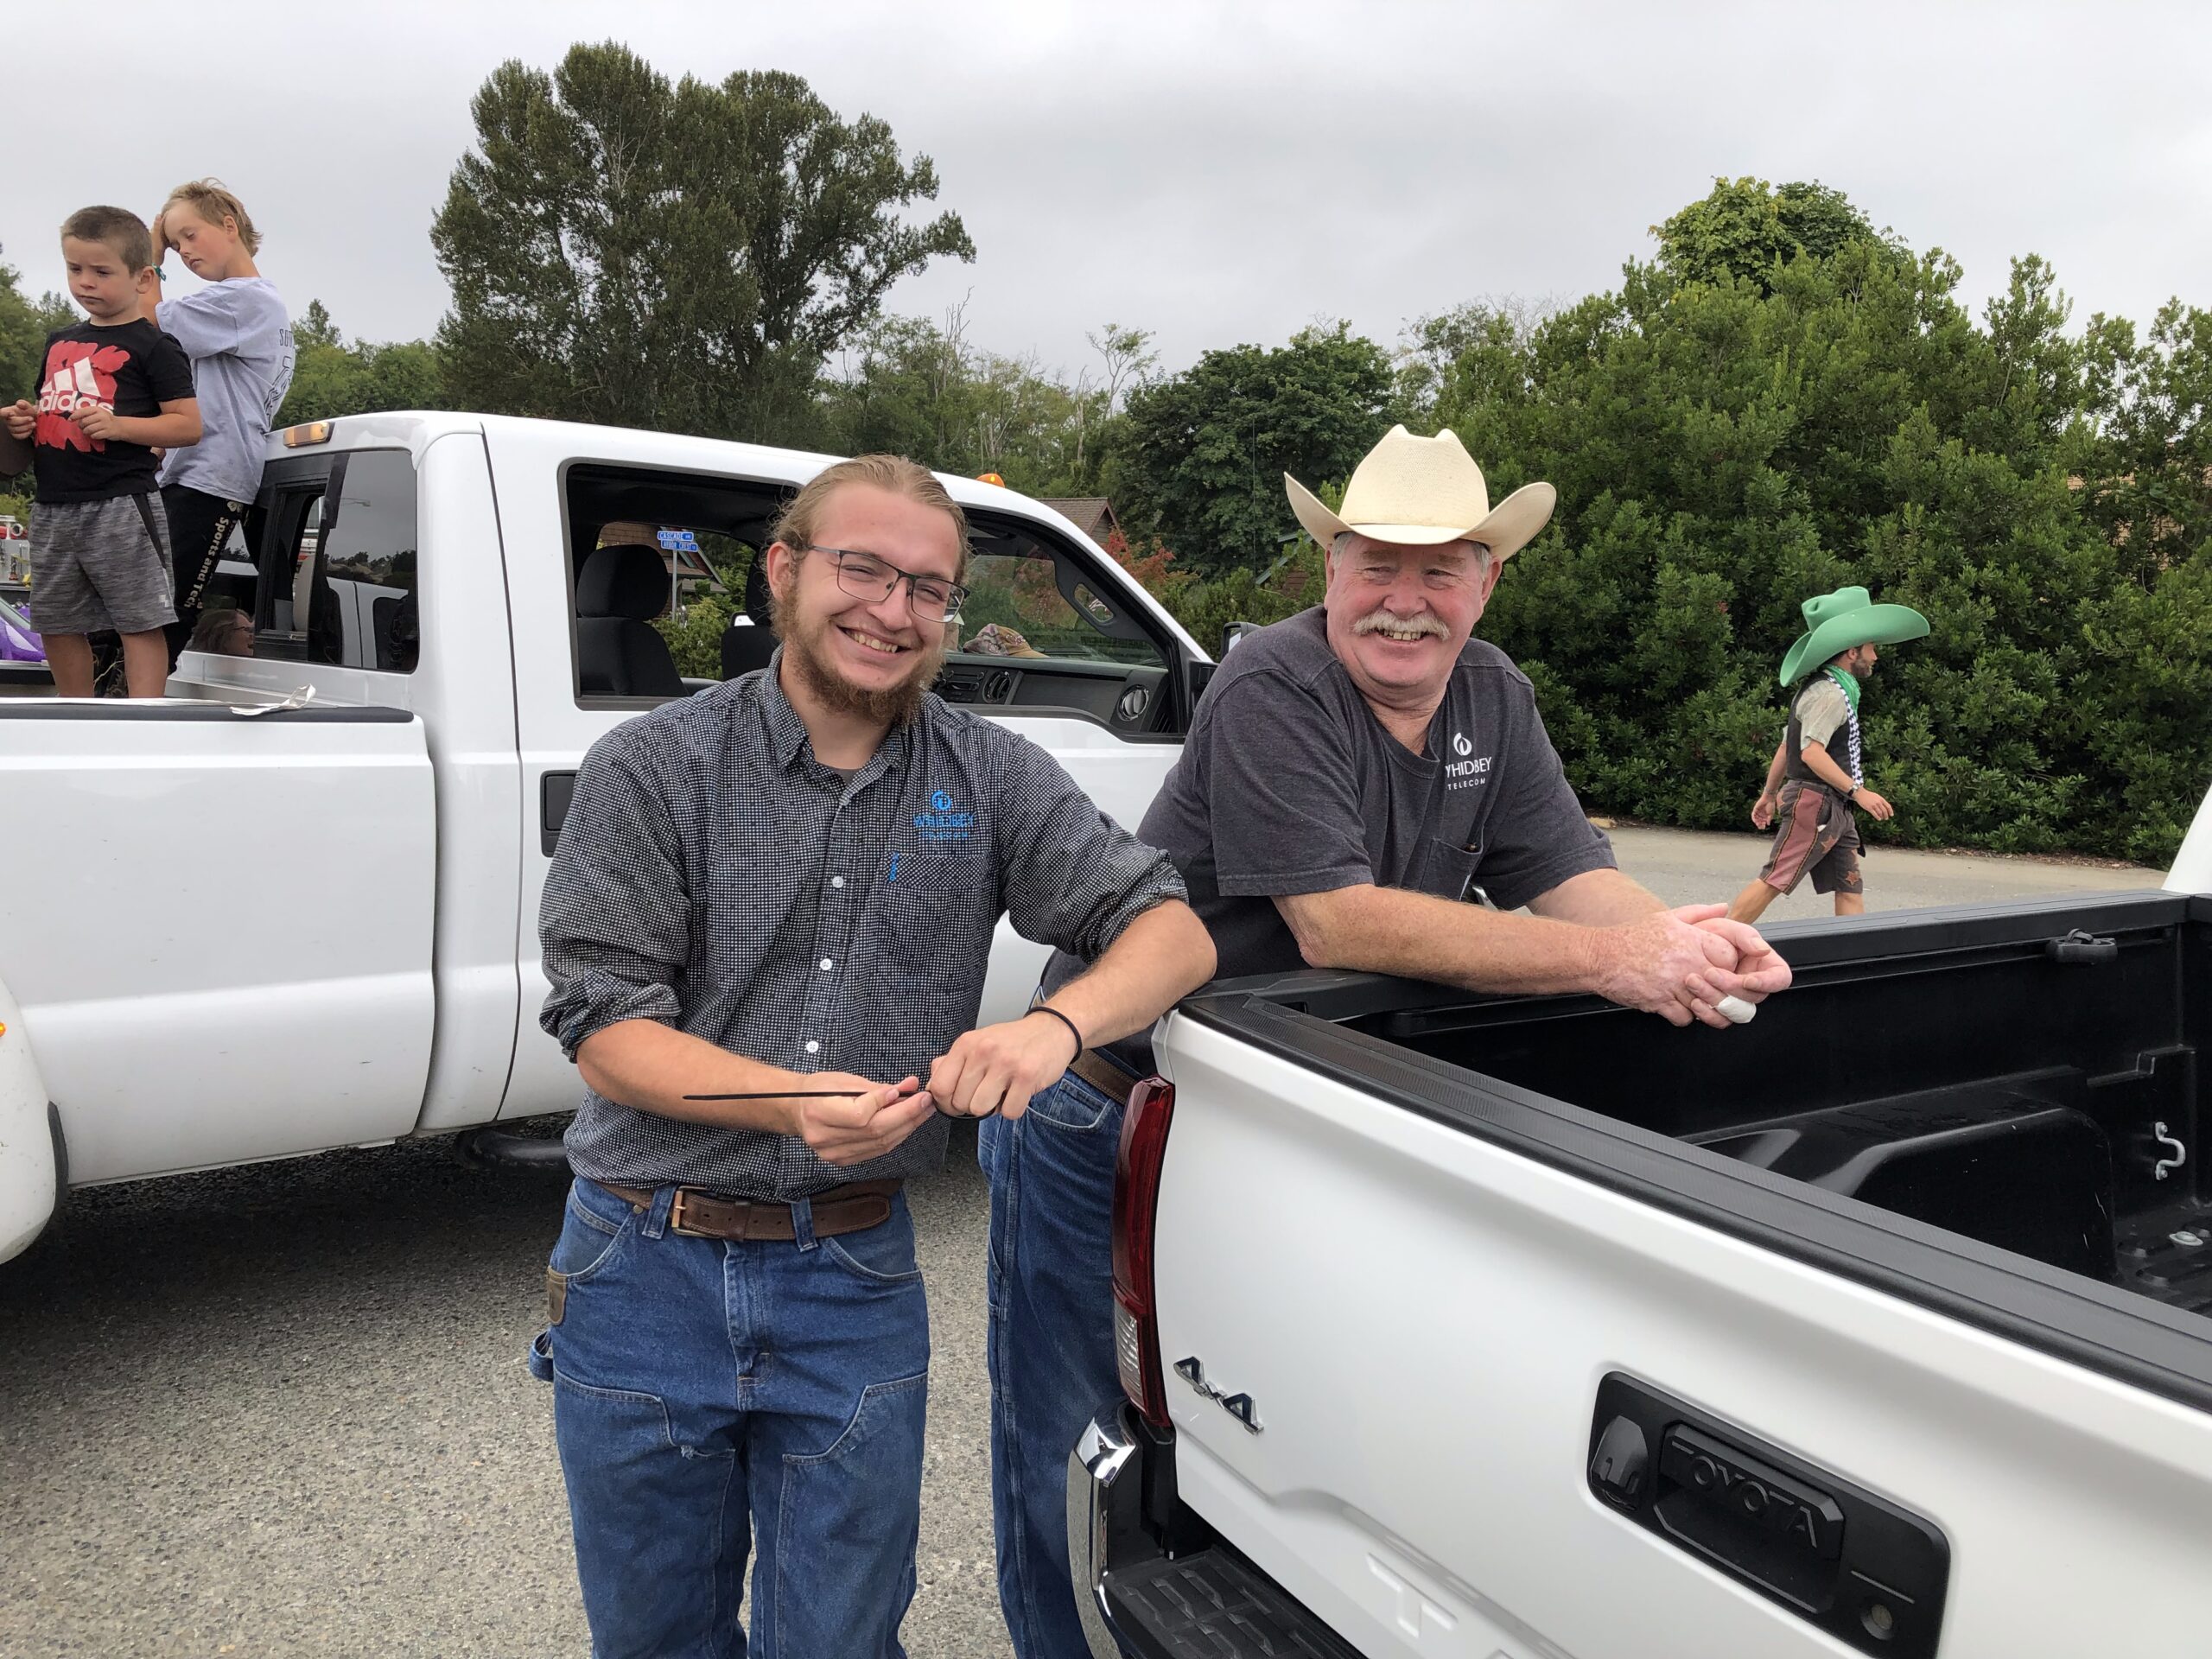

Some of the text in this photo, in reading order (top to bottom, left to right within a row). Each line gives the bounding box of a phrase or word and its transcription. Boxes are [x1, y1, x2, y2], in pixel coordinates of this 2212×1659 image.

[38, 391, 114, 415] didas
[207, 517, 229, 557] Sports
[197, 557, 213, 582] and
[183, 583, 204, 608] Tech
[1447, 778, 1486, 791] TELECOM
[913, 811, 976, 828] WHIDBEY
[1671, 1440, 1817, 1548] TOYOTA
